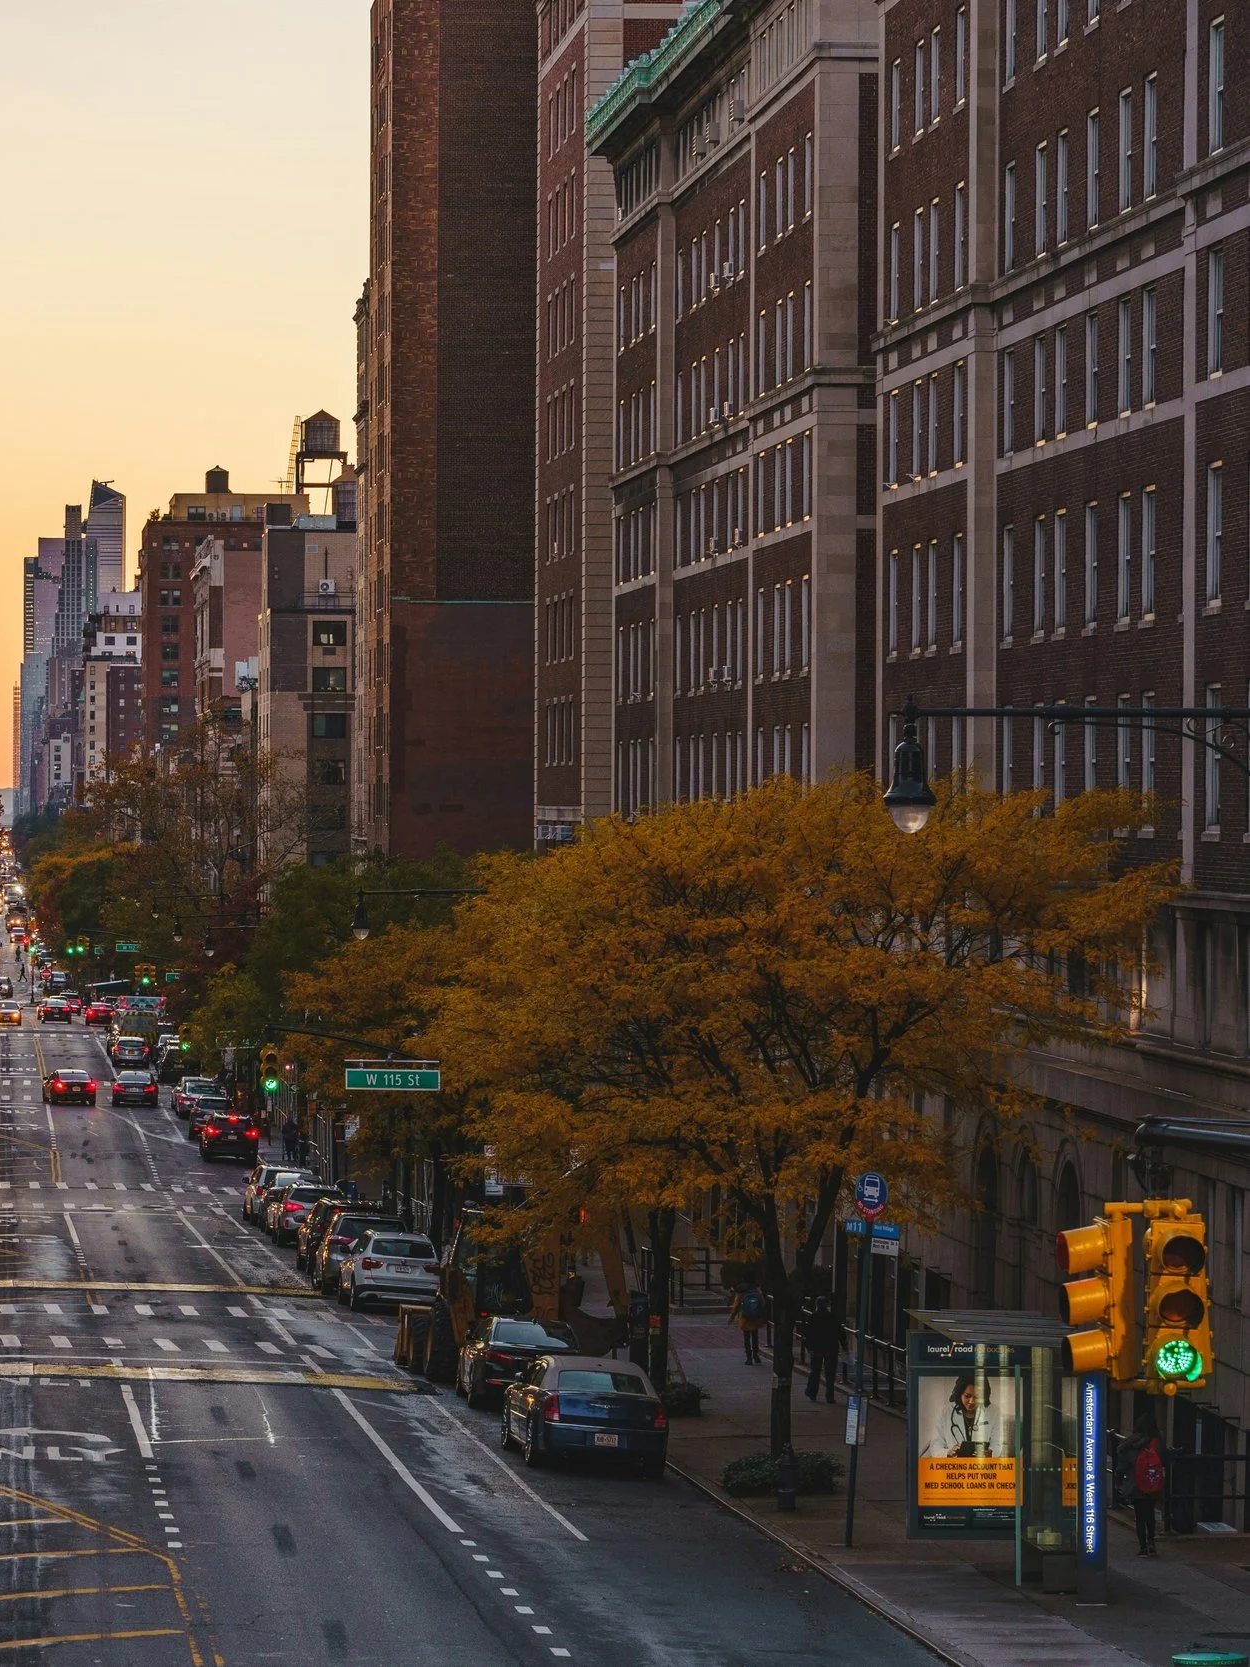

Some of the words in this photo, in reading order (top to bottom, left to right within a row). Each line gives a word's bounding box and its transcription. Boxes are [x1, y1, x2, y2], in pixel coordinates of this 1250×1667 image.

[365, 1073, 378, 1086] W
[383, 1073, 402, 1086] 115
[407, 1074, 420, 1086] St
[846, 1220, 863, 1233] M11
[927, 1345, 950, 1353] laurel
[954, 1345, 973, 1353] road
[1085, 1383, 1095, 1436] Amsterdam
[1085, 1437, 1095, 1472] Avenue
[929, 1463, 934, 1471] A
[935, 1463, 968, 1471] CHECKING
[968, 1463, 997, 1471] ACCOUNT
[999, 1463, 1014, 1471] THAT
[946, 1472, 966, 1480] HELPS
[967, 1472, 979, 1480] PUT
[980, 1472, 997, 1480] YOUR
[924, 1481, 939, 1489] MED
[940, 1481, 965, 1489] SCHOOL
[966, 1481, 986, 1489] LOANS
[988, 1481, 995, 1489] IN
[1085, 1482, 1095, 1507] West
[1085, 1508, 1095, 1523] 116
[1085, 1525, 1095, 1553] Street
